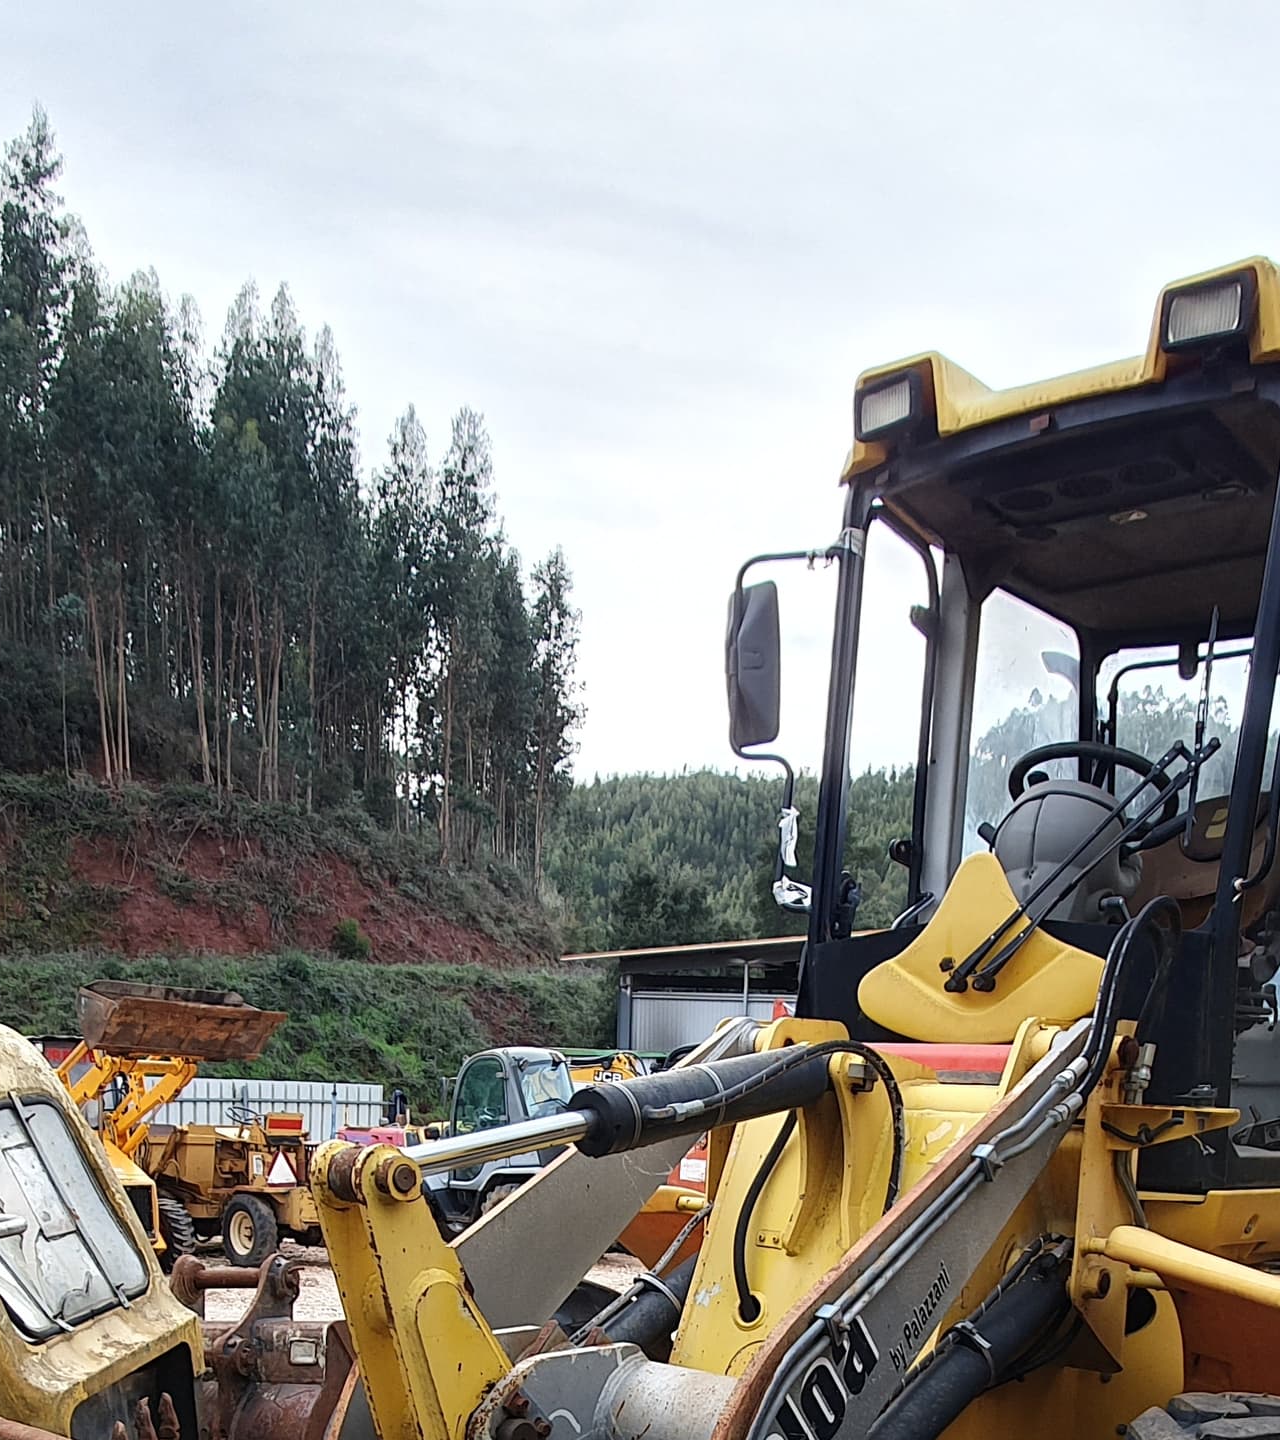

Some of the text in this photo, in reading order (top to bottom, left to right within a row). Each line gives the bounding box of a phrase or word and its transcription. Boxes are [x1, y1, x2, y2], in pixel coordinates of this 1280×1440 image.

[593, 1070, 623, 1082] JCB
[888, 1260, 951, 1373] by Palazzani
